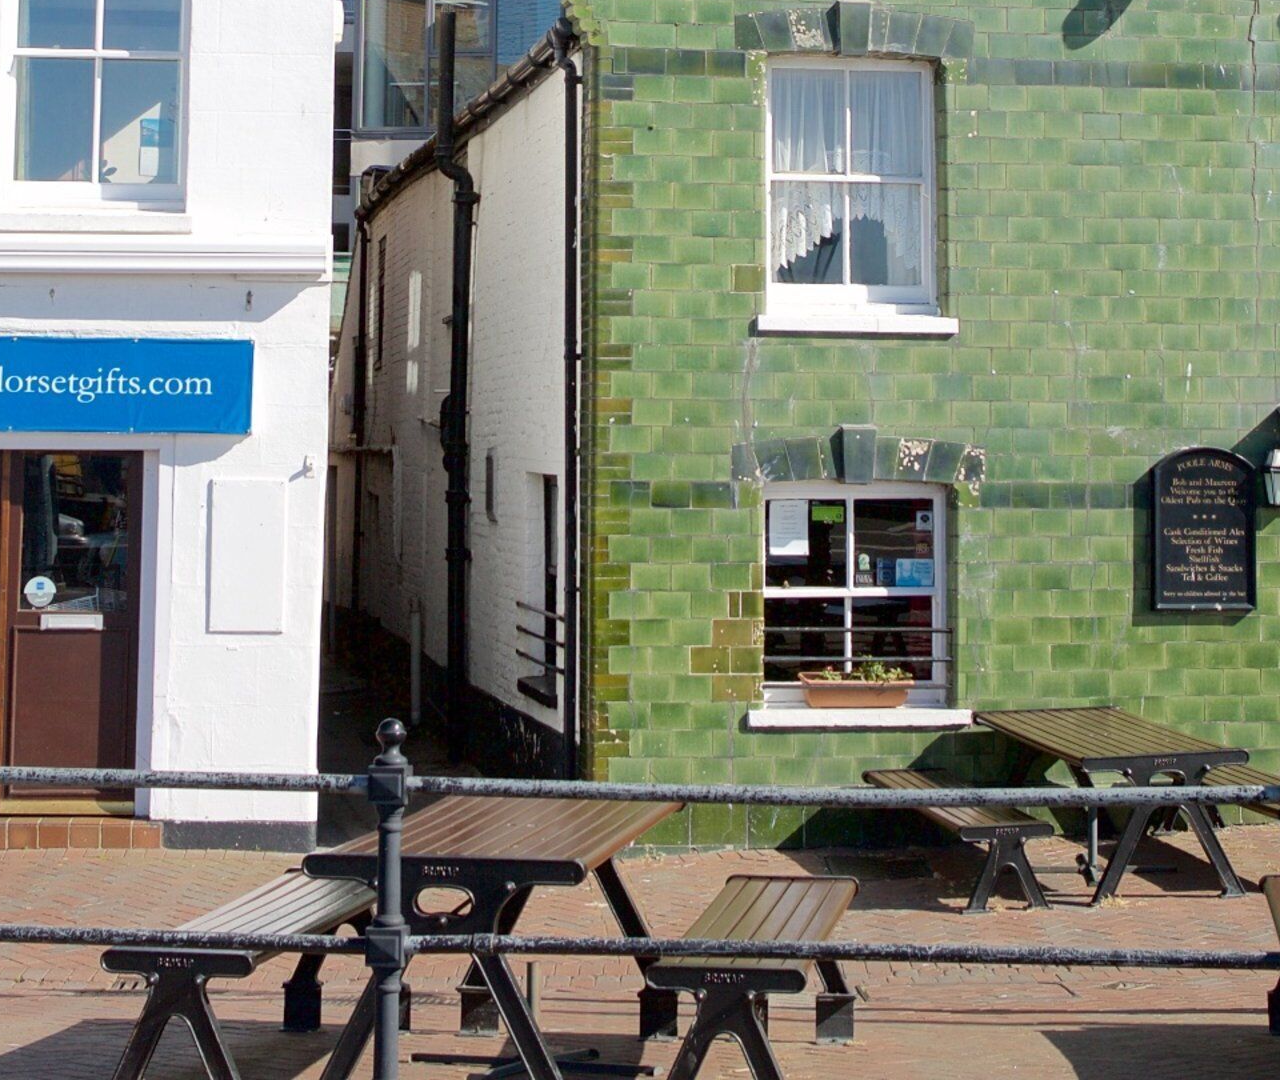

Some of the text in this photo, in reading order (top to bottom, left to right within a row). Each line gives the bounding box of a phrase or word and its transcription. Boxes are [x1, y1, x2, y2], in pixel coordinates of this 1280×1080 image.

[1176, 458, 1232, 471] POOLE ARMS
[1172, 478, 1237, 486] Bob and Maureen
[1170, 486, 1200, 495] Welcome
[1203, 489, 1216, 497] you
[1160, 496, 1184, 505] Oldest
[1186, 496, 1201, 504] Pub
[1214, 496, 1226, 504] the
[1163, 528, 1245, 536] Cask Conditioned Ales
[1171, 537, 1202, 545] Selection
[1214, 537, 1238, 545] Wines
[1186, 545, 1223, 554] Fresh Fish
[1189, 555, 1220, 563] Shellfish
[1166, 564, 1243, 572] Sandwiches & Snacks
[1181, 573, 1228, 582] Tea & Coffee
